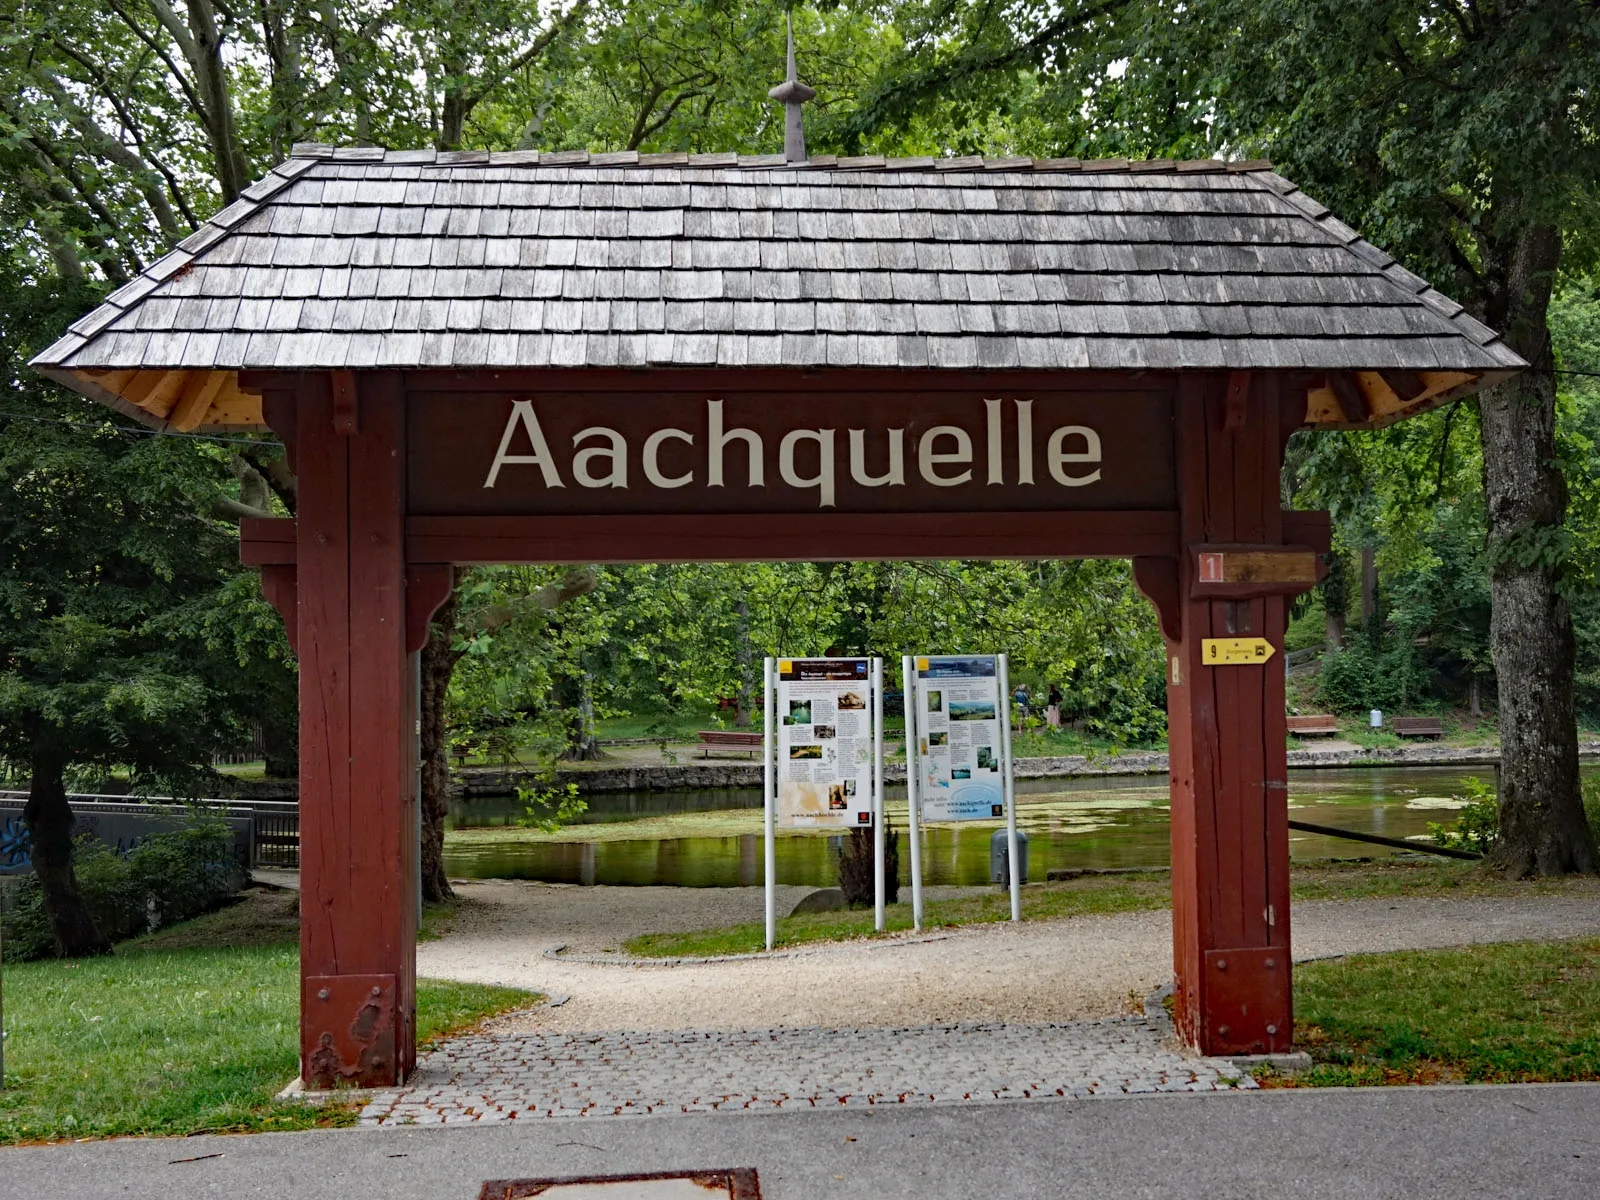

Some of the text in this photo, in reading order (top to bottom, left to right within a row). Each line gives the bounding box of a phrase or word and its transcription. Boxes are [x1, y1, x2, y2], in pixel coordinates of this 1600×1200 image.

[483, 398, 1102, 508] Aachquelle
[1206, 557, 1215, 579] 1
[1211, 644, 1217, 658] 9
